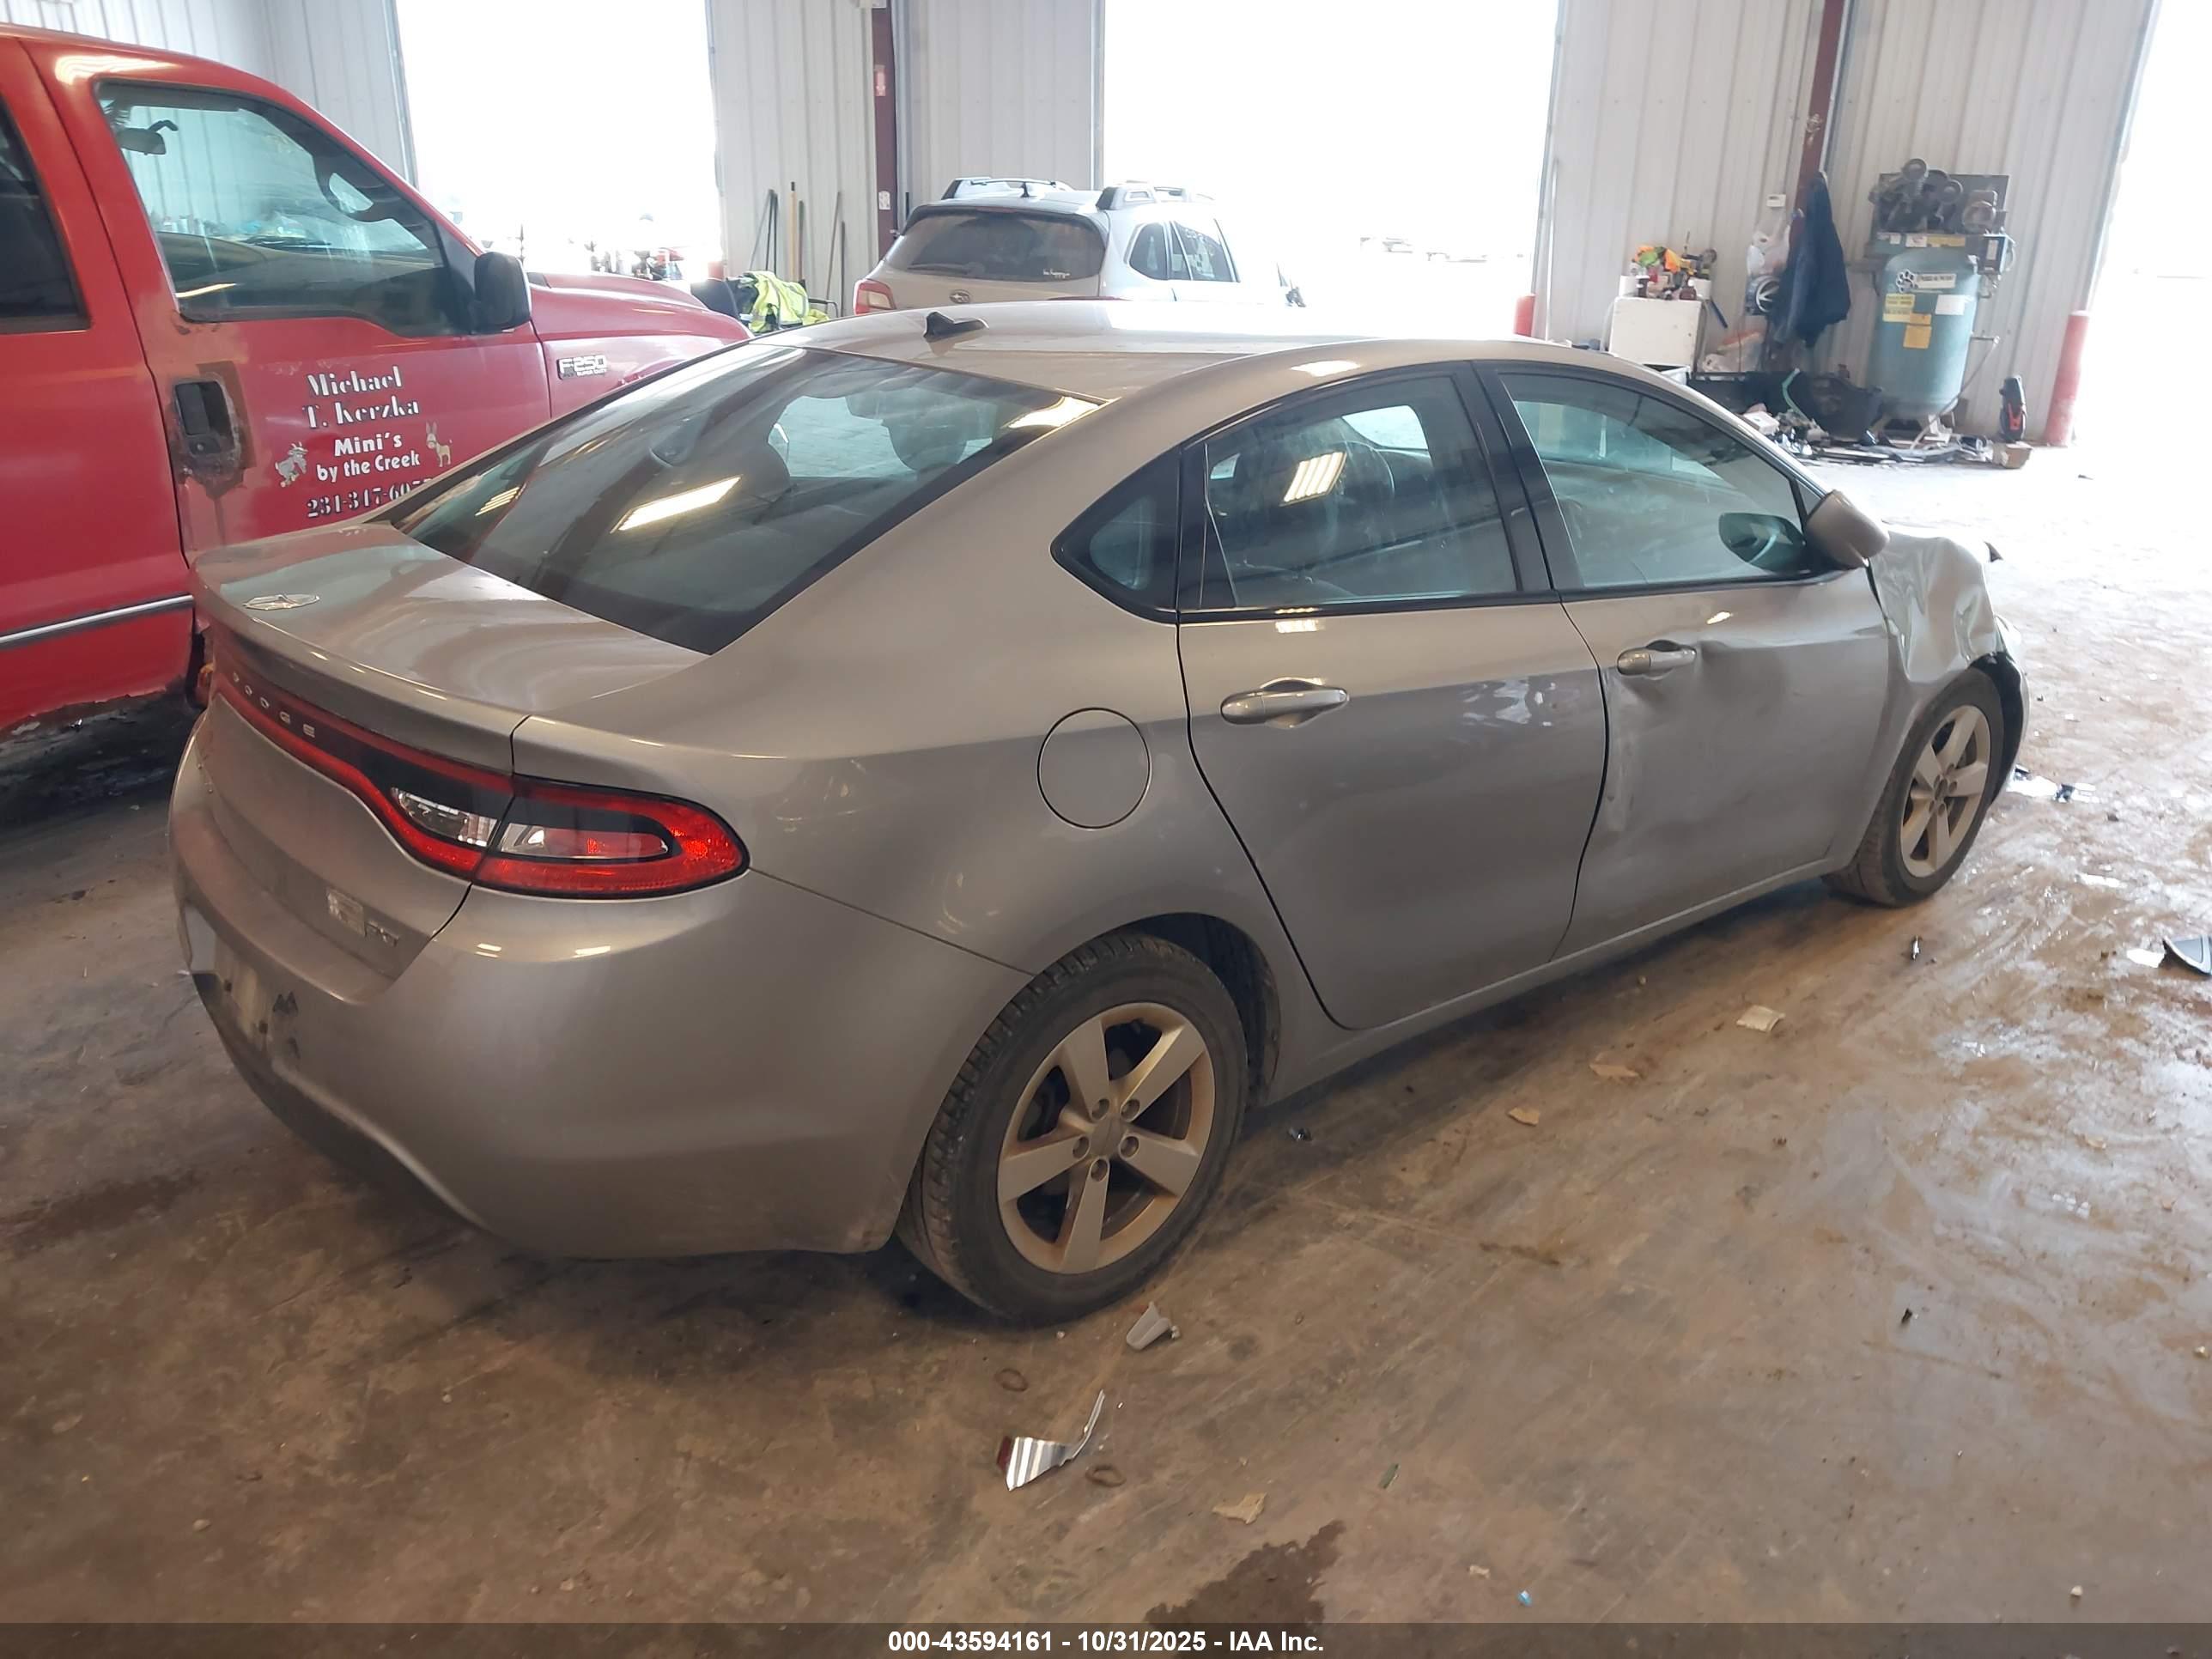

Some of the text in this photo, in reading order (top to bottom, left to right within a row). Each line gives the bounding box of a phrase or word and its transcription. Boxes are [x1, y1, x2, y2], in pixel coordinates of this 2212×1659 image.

[307, 366, 402, 396] Michael
[301, 404, 328, 428] T.
[335, 432, 403, 457] Mini's
[316, 450, 420, 483] by the Creek
